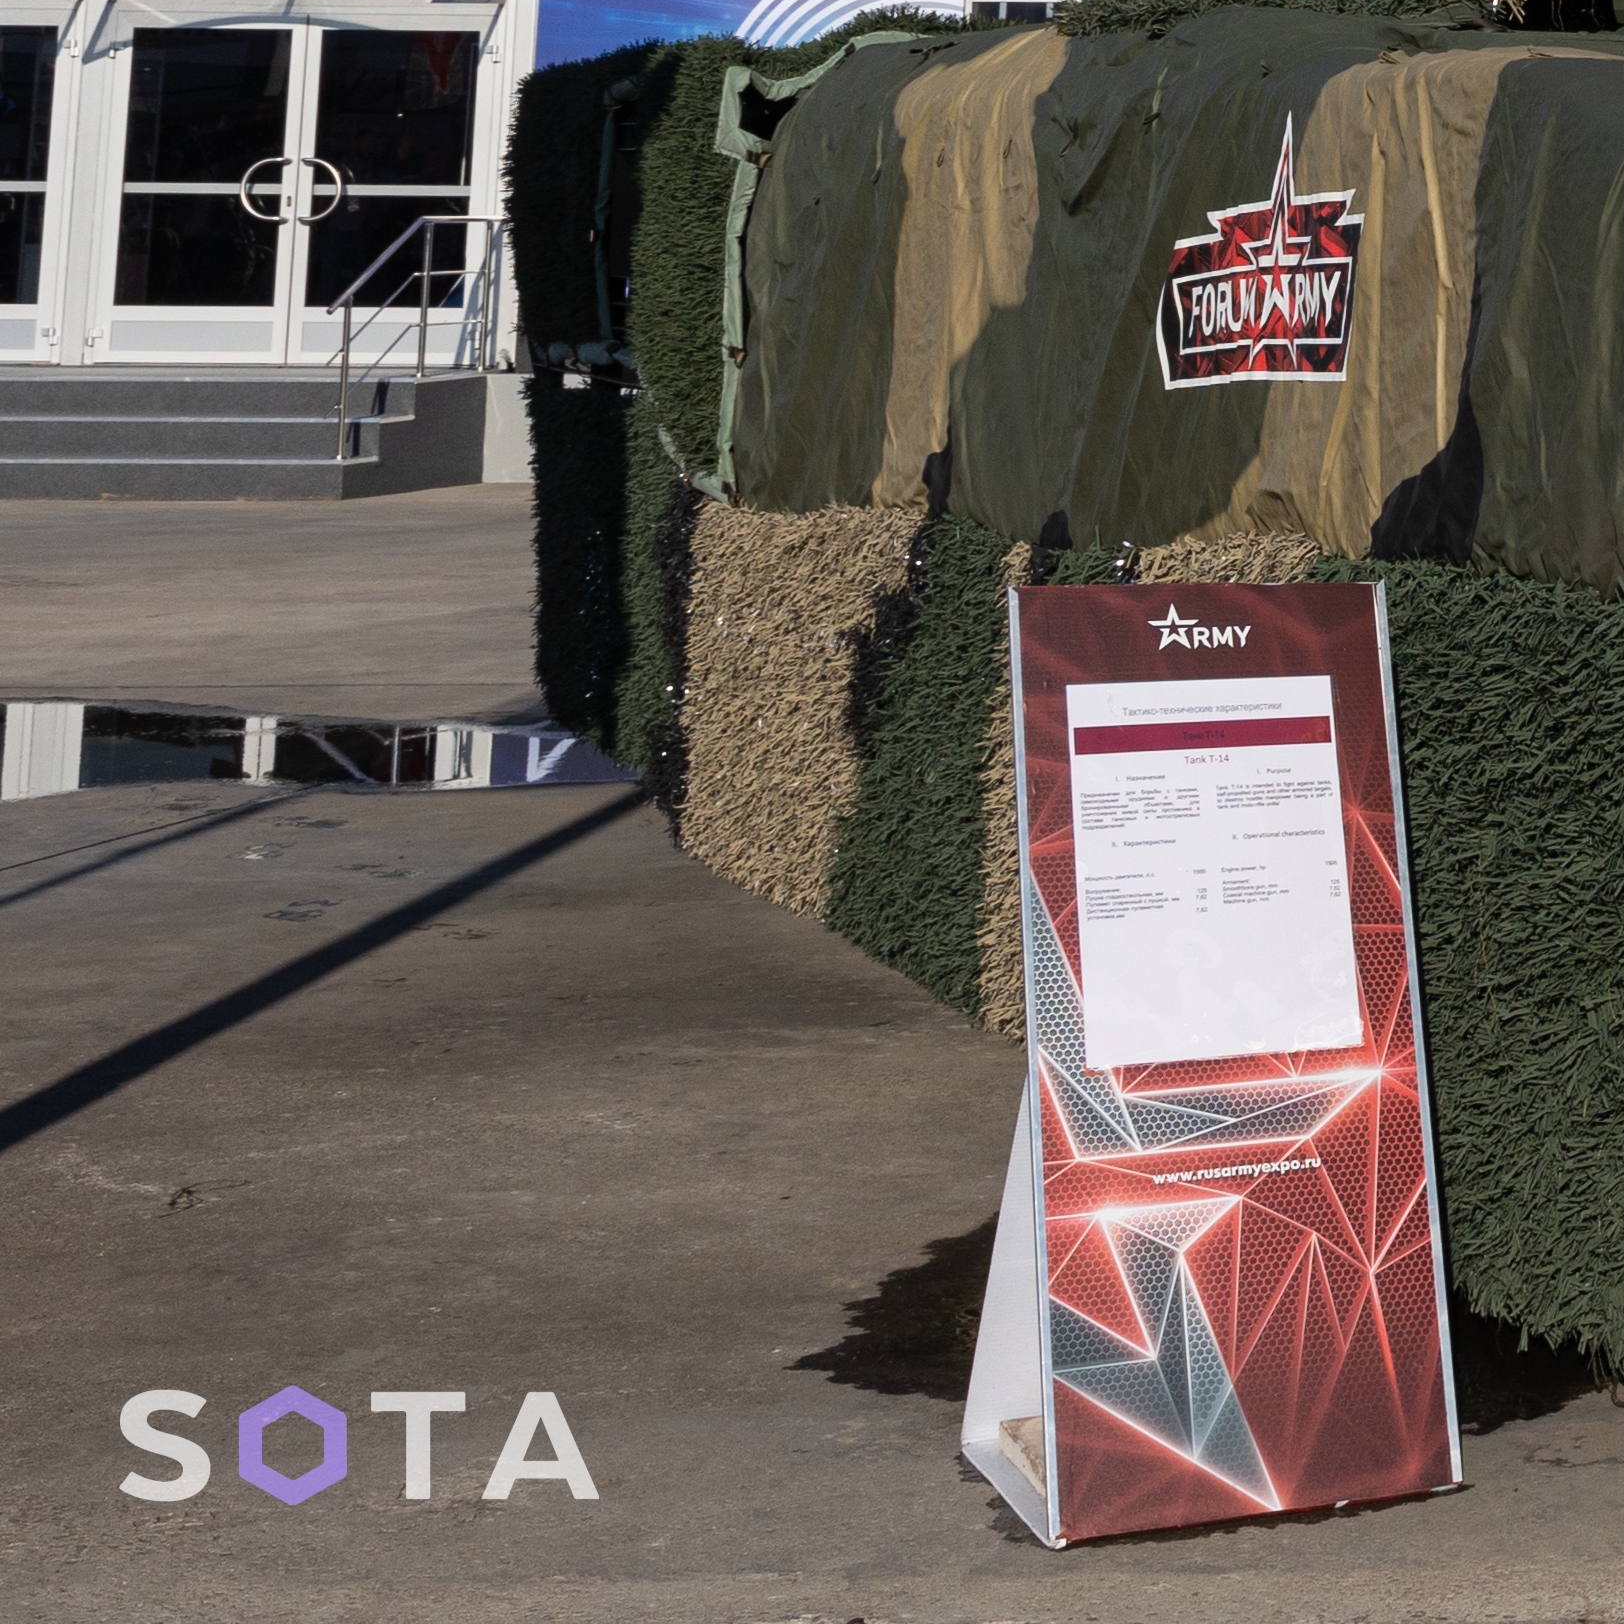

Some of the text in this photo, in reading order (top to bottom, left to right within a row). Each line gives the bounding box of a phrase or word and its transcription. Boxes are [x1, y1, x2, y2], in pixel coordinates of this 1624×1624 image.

[1148, 603, 1252, 651] ARMY
[1184, 754, 1230, 764] Tank T-14
[1153, 1156, 1322, 1185] www.rusarmyexpo.ru
